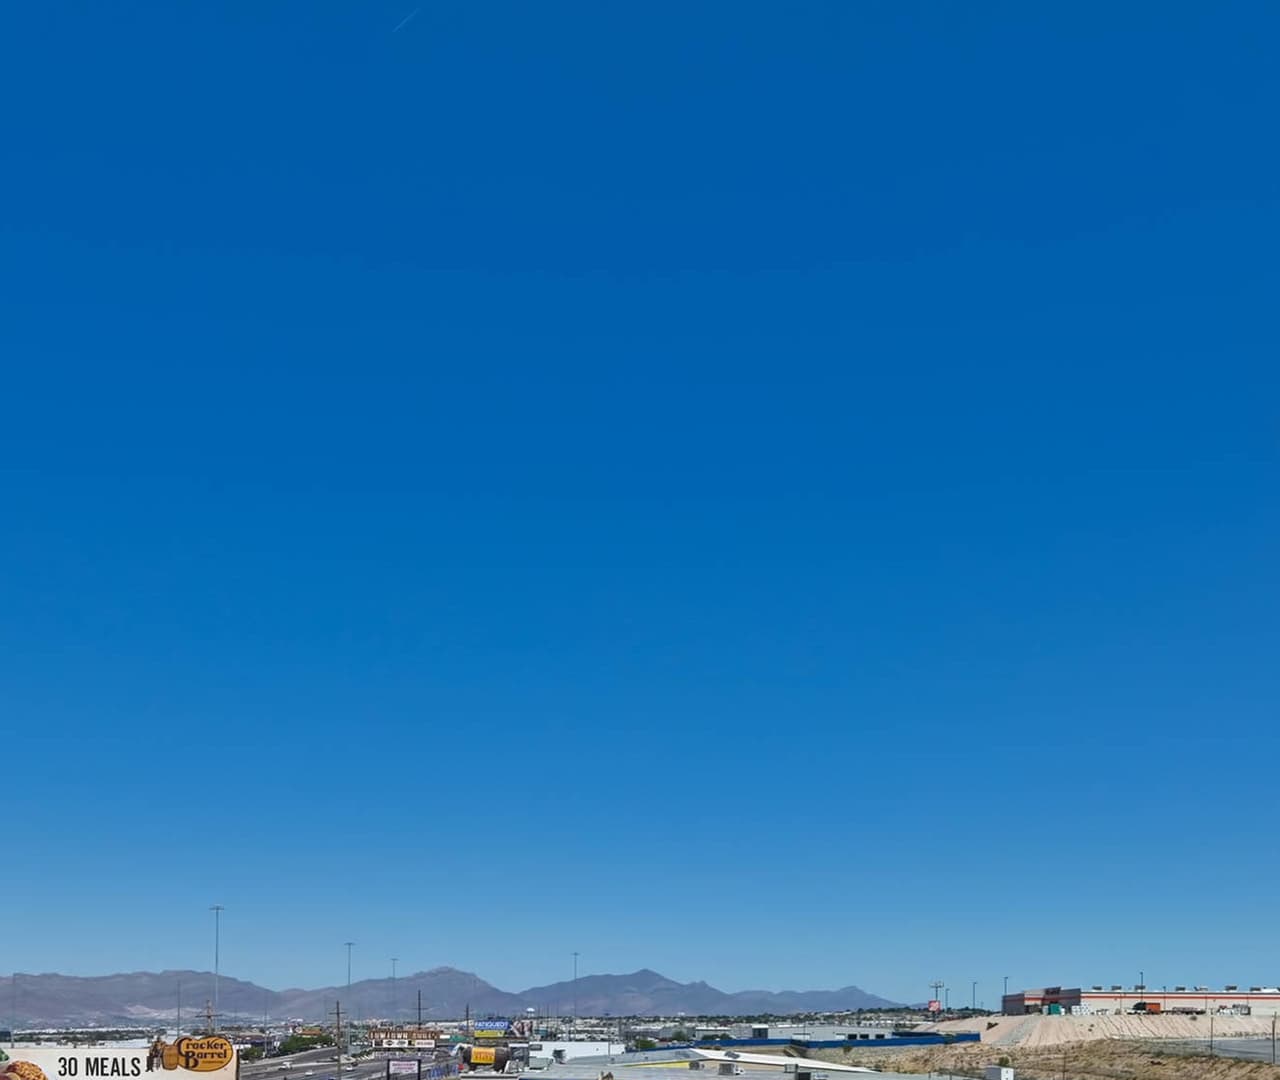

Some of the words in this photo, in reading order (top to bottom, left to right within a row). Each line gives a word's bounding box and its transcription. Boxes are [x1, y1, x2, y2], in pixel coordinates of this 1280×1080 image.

[177, 1037, 226, 1057] Cracker
[58, 1057, 77, 1076] 30
[85, 1057, 141, 1076] MEALS
[184, 1050, 227, 1068] Barrel
